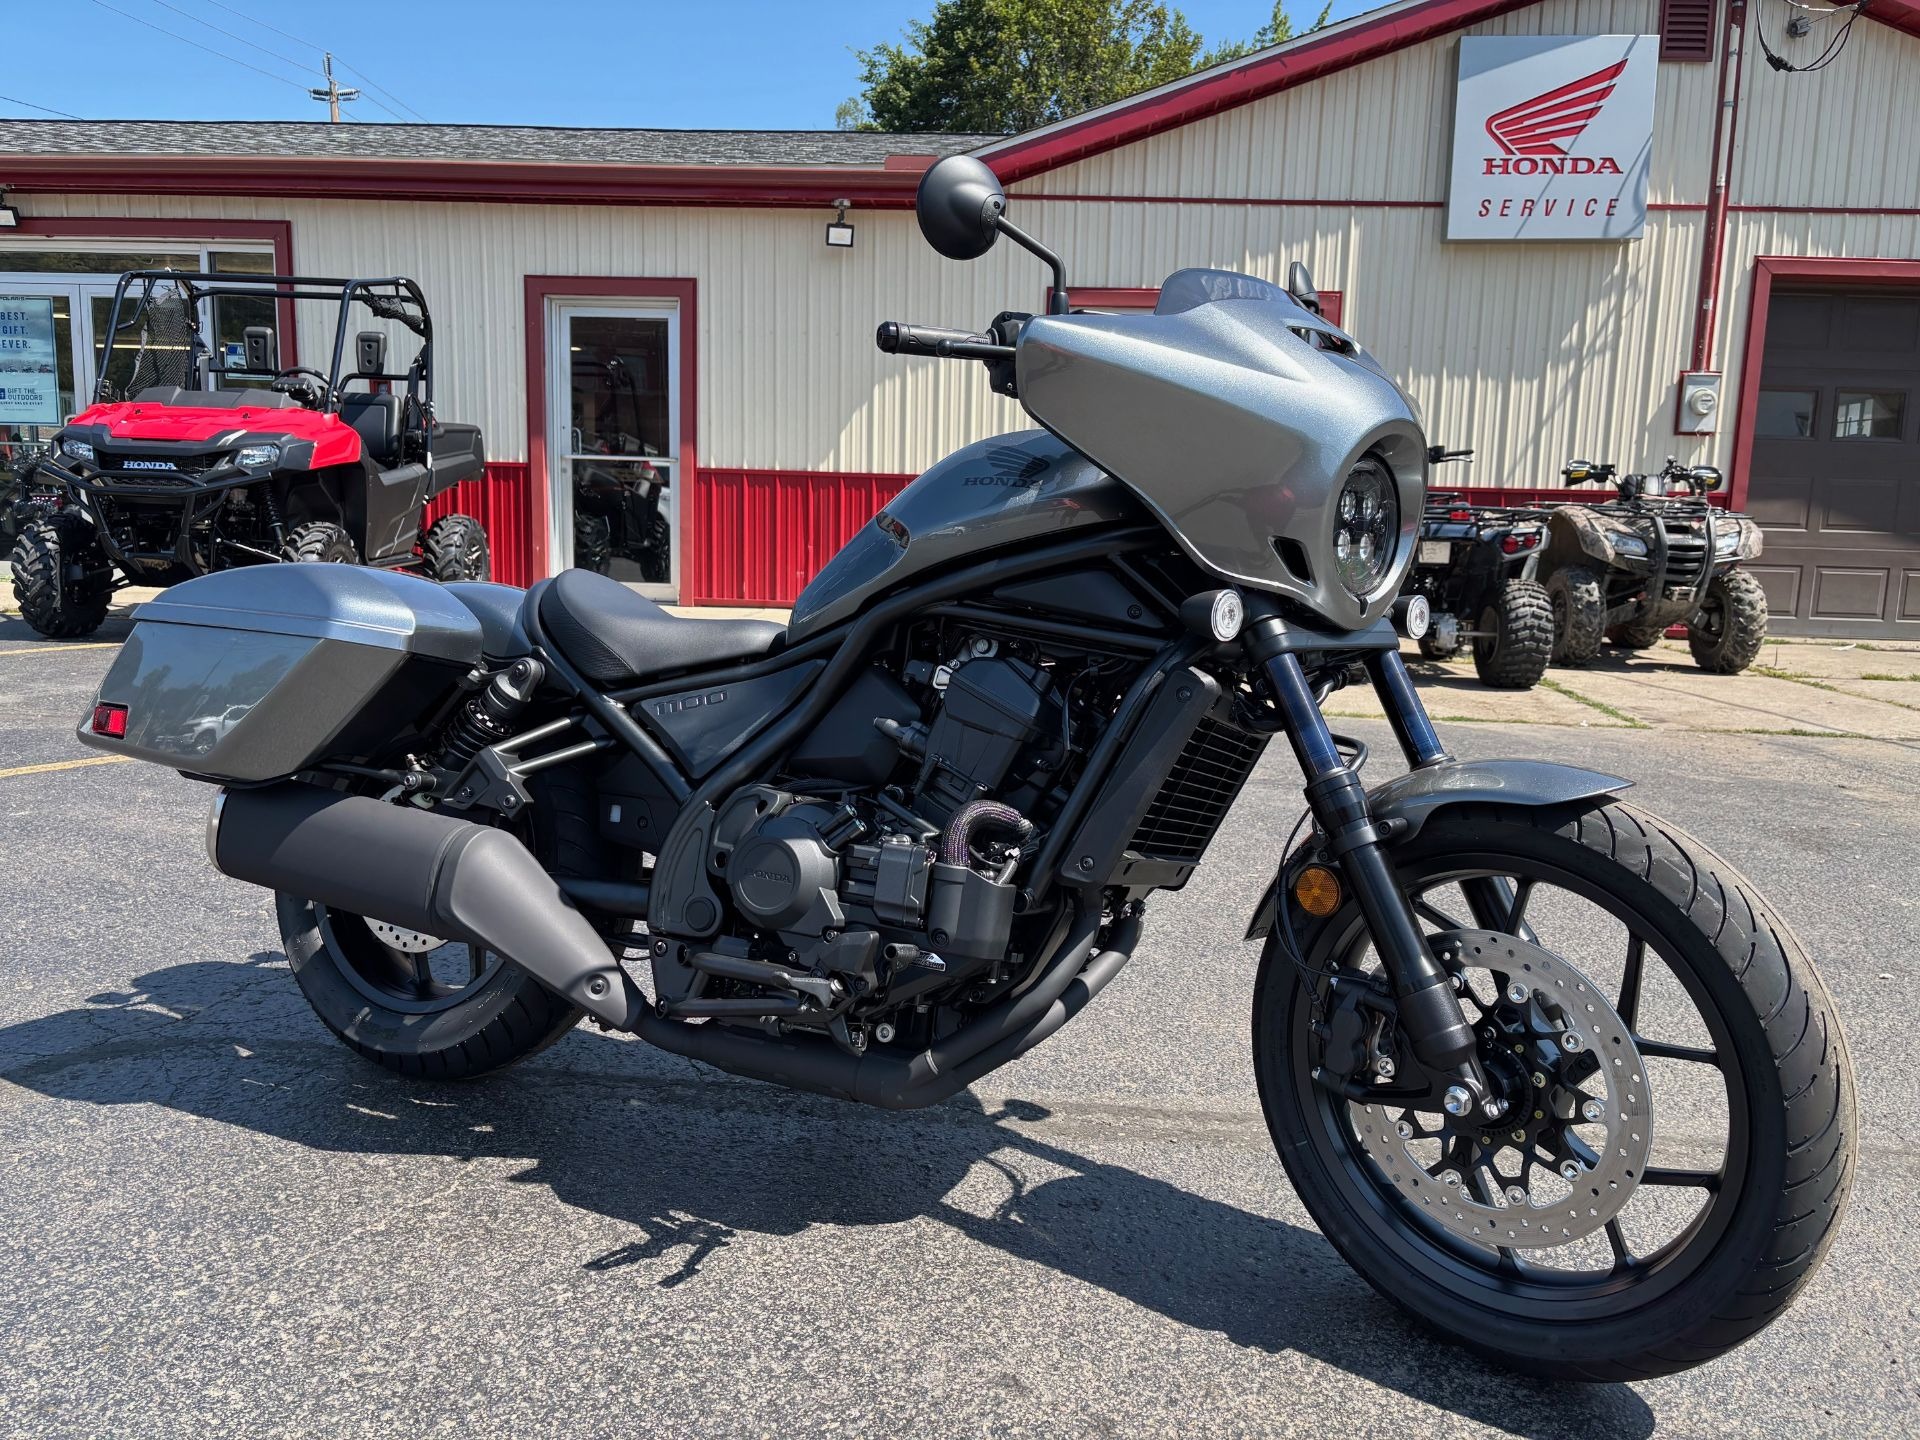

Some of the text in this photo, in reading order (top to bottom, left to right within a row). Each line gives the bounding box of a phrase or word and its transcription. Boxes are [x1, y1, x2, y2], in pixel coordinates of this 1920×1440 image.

[1481, 157, 1623, 176] HONDA
[1478, 198, 1619, 217] SERVICE
[0, 311, 29, 321] BEST.
[2, 325, 29, 335] GIFT.
[1, 339, 31, 349] EVER.
[123, 460, 178, 470] HONDA
[654, 690, 728, 715] 1100
